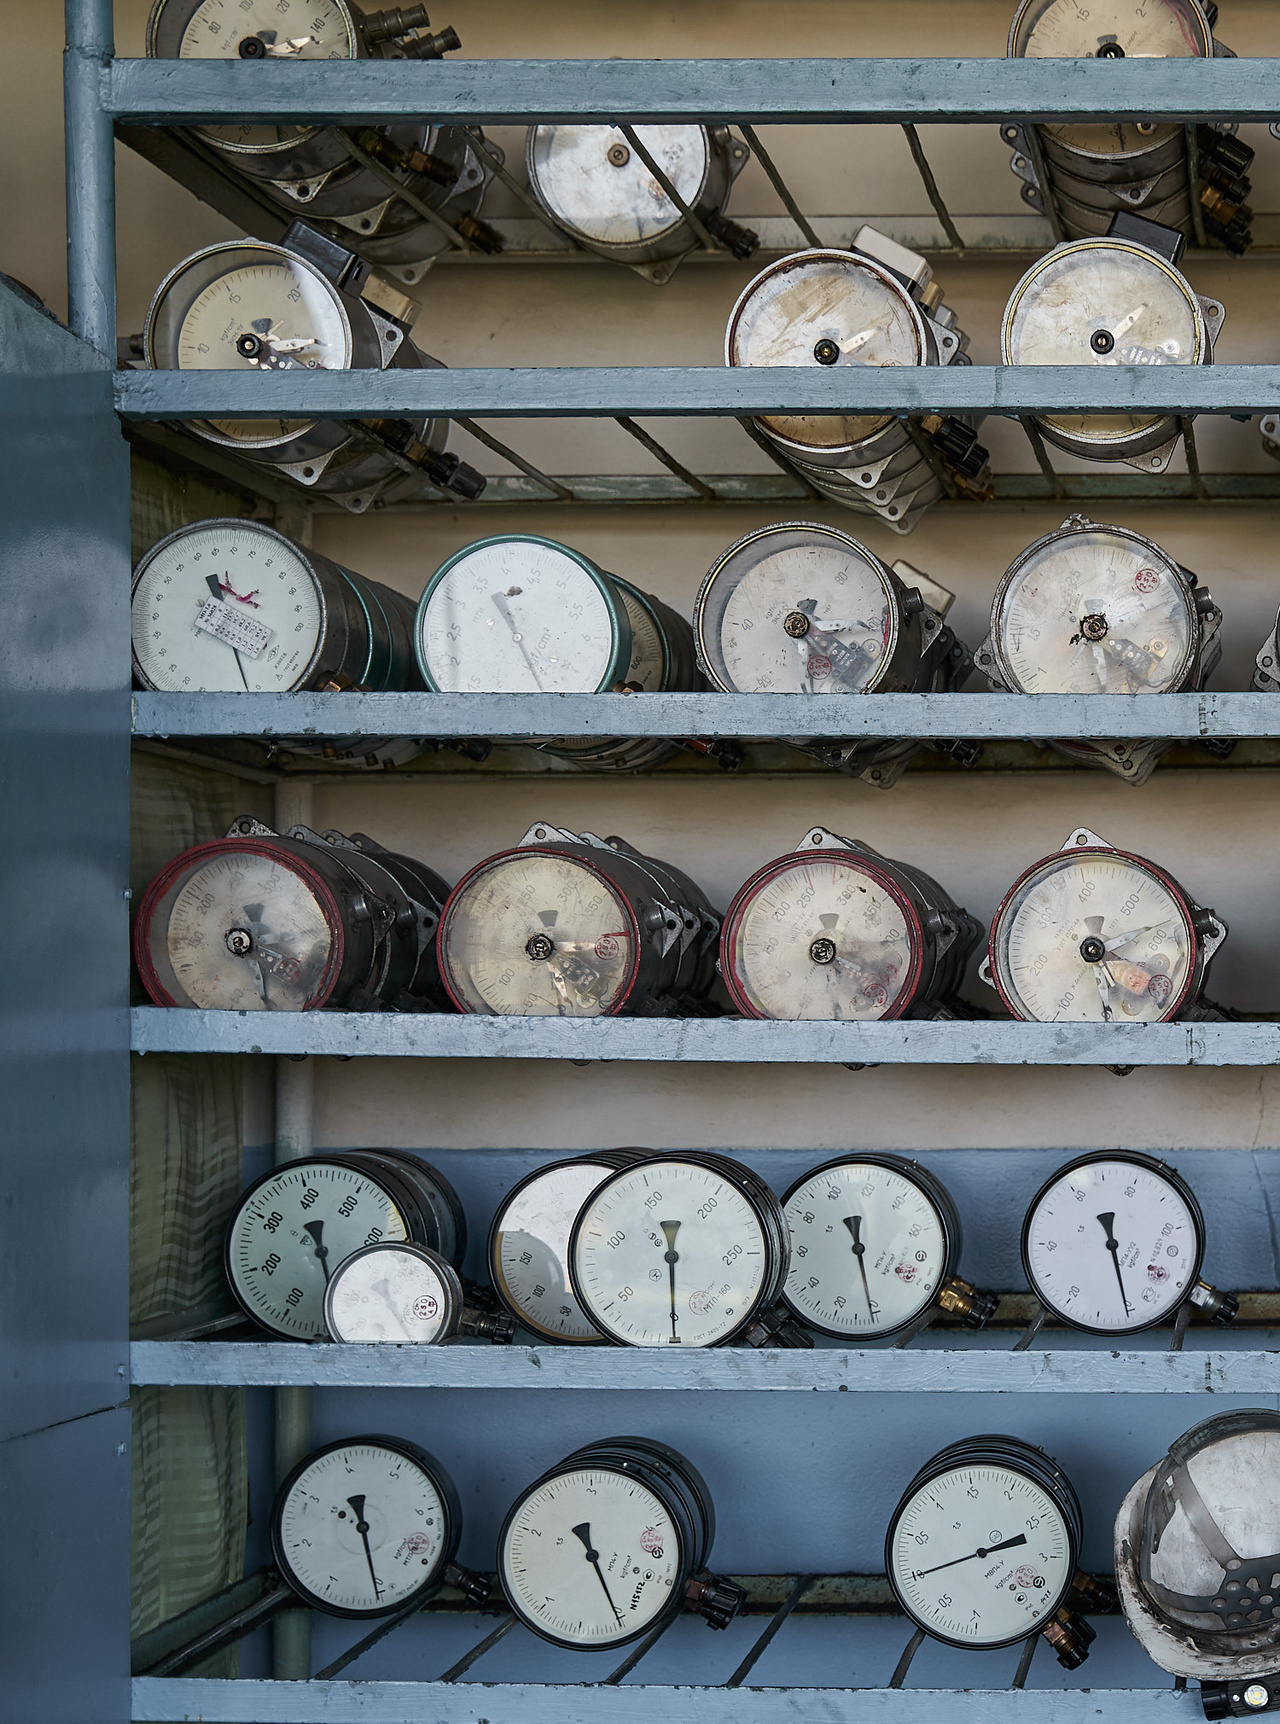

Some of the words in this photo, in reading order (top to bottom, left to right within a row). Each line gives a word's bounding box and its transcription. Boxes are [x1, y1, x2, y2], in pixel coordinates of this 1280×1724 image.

[1136, 8, 1146, 18] 2
[208, 21, 222, 34] 80
[310, 18, 326, 33] 140
[228, 294, 241, 304] 15
[287, 289, 301, 302] 20
[197, 344, 210, 353] 10
[211, 548, 220, 557] 65
[229, 547, 238, 555] 70
[248, 550, 257, 559] 75
[194, 553, 202, 562] 60
[265, 559, 273, 567] 80
[176, 564, 185, 572] 55
[502, 567, 511, 575] 4
[1107, 568, 1116, 576] 3
[164, 576, 173, 585] 50
[557, 580, 566, 589] 5
[835, 572, 848, 585] 80
[155, 593, 164, 602] 45
[288, 588, 297, 596] 90
[294, 604, 302, 613] 95
[456, 600, 466, 609] 3
[152, 613, 160, 621] 40
[295, 623, 304, 633] 100
[741, 619, 753, 631] 40
[153, 631, 161, 639] 35
[158, 648, 167, 656] 30
[169, 663, 177, 672] 25
[631, 656, 642, 669] 600
[182, 677, 191, 685] 20
[797, 887, 815, 909] 250
[1078, 881, 1096, 903] 400
[196, 893, 215, 916] 200
[1120, 893, 1140, 916] 500
[771, 901, 791, 923] 200
[1039, 907, 1055, 929] 300
[1148, 929, 1167, 951] 600
[1030, 954, 1048, 976] 200
[499, 968, 515, 986] 100
[1058, 991, 1075, 1011] 100
[828, 1186, 842, 1202] 100
[861, 1183, 875, 1198] 120
[1074, 1190, 1086, 1202] 60
[1124, 1186, 1136, 1198] 80
[300, 1188, 319, 1210] 400
[644, 1191, 663, 1210] 150
[892, 1196, 905, 1211] 140
[338, 1196, 358, 1218] 500
[697, 1197, 718, 1219] 200
[264, 1212, 283, 1234] 300
[803, 1212, 815, 1224] 80
[909, 1223, 922, 1238] 160
[1161, 1223, 1174, 1237] 100
[364, 1227, 383, 1246] 600
[607, 1231, 626, 1249] 100
[797, 1246, 808, 1258] 60
[1046, 1241, 1057, 1251] 40
[519, 1252, 533, 1266] 150
[723, 1245, 743, 1266] 250
[262, 1253, 281, 1276] 200
[808, 1277, 819, 1288] 40
[533, 1285, 546, 1298] 100
[618, 1286, 634, 1303] 50
[1069, 1286, 1080, 1297] 20
[286, 1288, 304, 1308] 100
[702, 1284, 731, 1313] МТП-160
[834, 1296, 846, 1308] 20
[561, 1307, 572, 1317] 50
[310, 1495, 319, 1503] 3
[1004, 1490, 1013, 1501] 2
[936, 1502, 944, 1510] 1
[531, 1529, 541, 1537] 2
[302, 1539, 312, 1547] 2
[1038, 1553, 1048, 1562] 3
